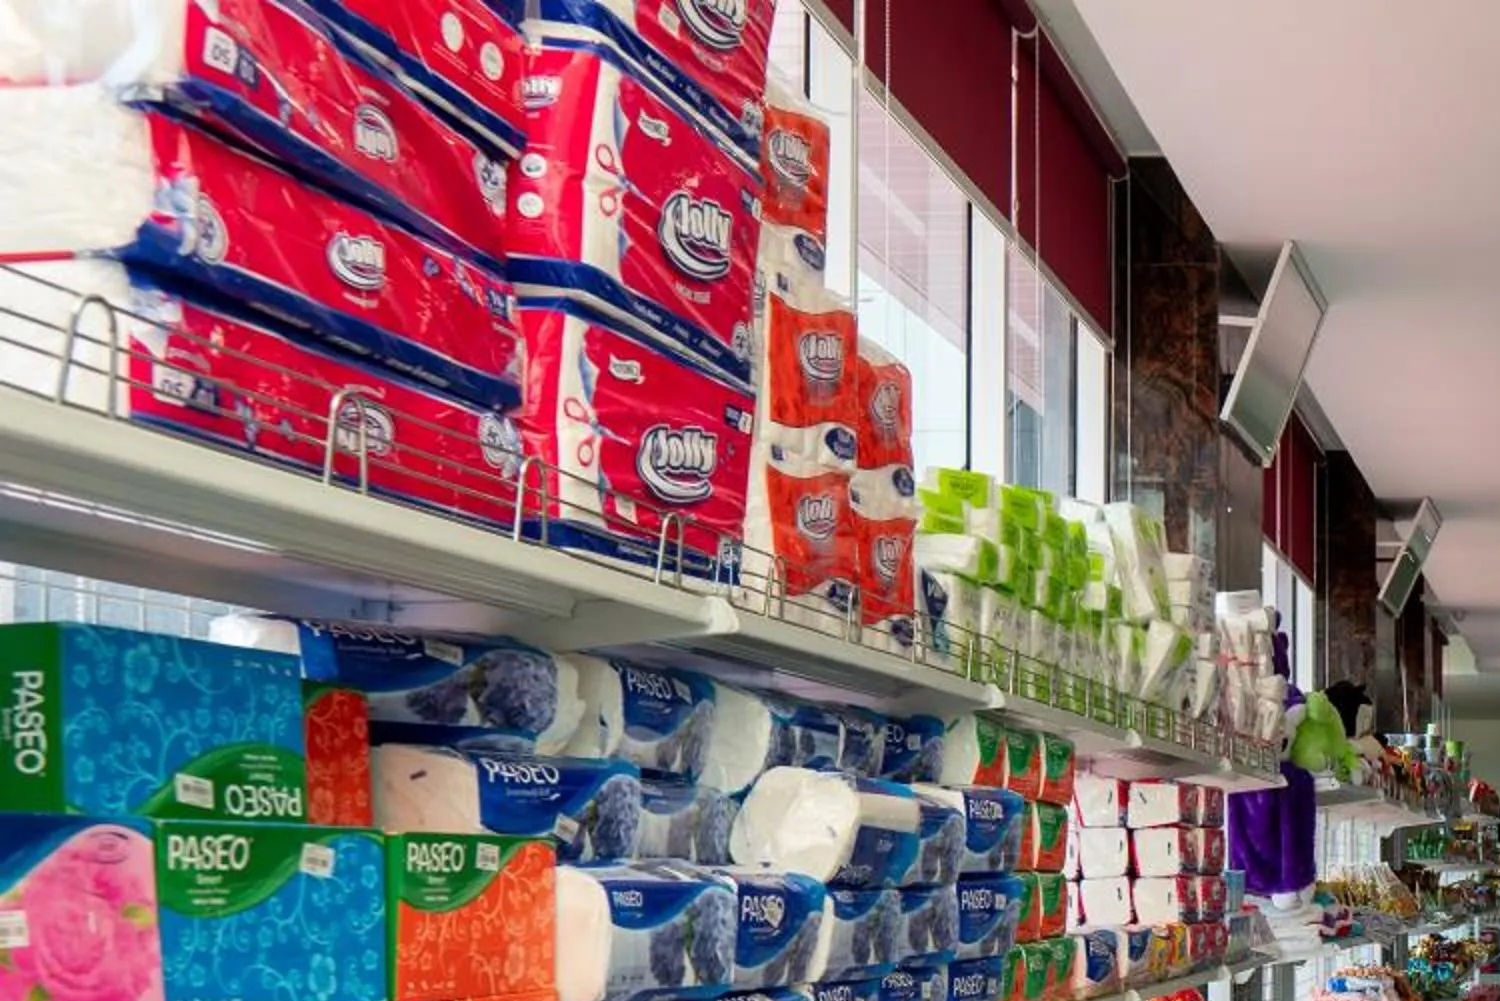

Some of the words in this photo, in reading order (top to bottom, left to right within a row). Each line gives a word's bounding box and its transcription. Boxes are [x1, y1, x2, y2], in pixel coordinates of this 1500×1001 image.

[662, 191, 732, 274] Jolly
[642, 424, 717, 492] Jolly
[12, 670, 48, 775] PASEO
[224, 785, 303, 818] PASEO
[167, 833, 251, 871] PASEO
[407, 841, 464, 872] PASEO
